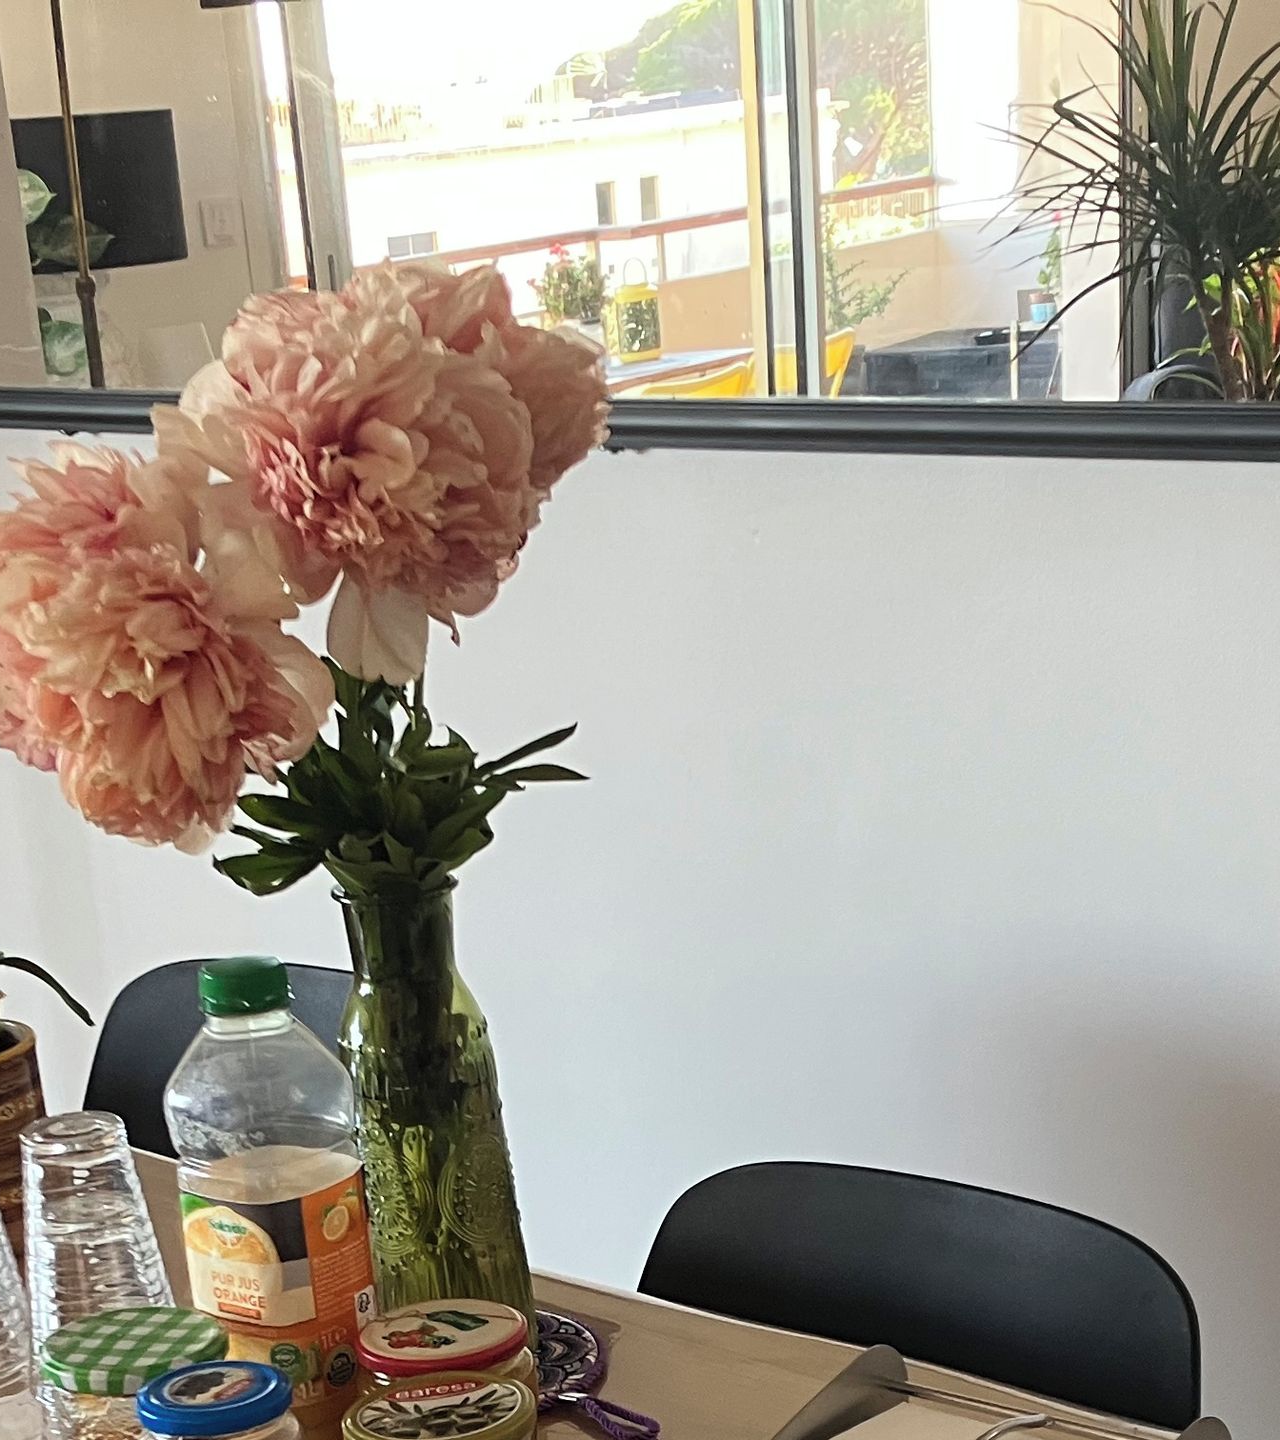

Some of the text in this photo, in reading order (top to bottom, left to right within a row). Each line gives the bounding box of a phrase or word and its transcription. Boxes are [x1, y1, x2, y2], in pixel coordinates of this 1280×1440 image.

[211, 1271, 260, 1291] PUR JUS
[213, 1286, 267, 1309] ORANGE
